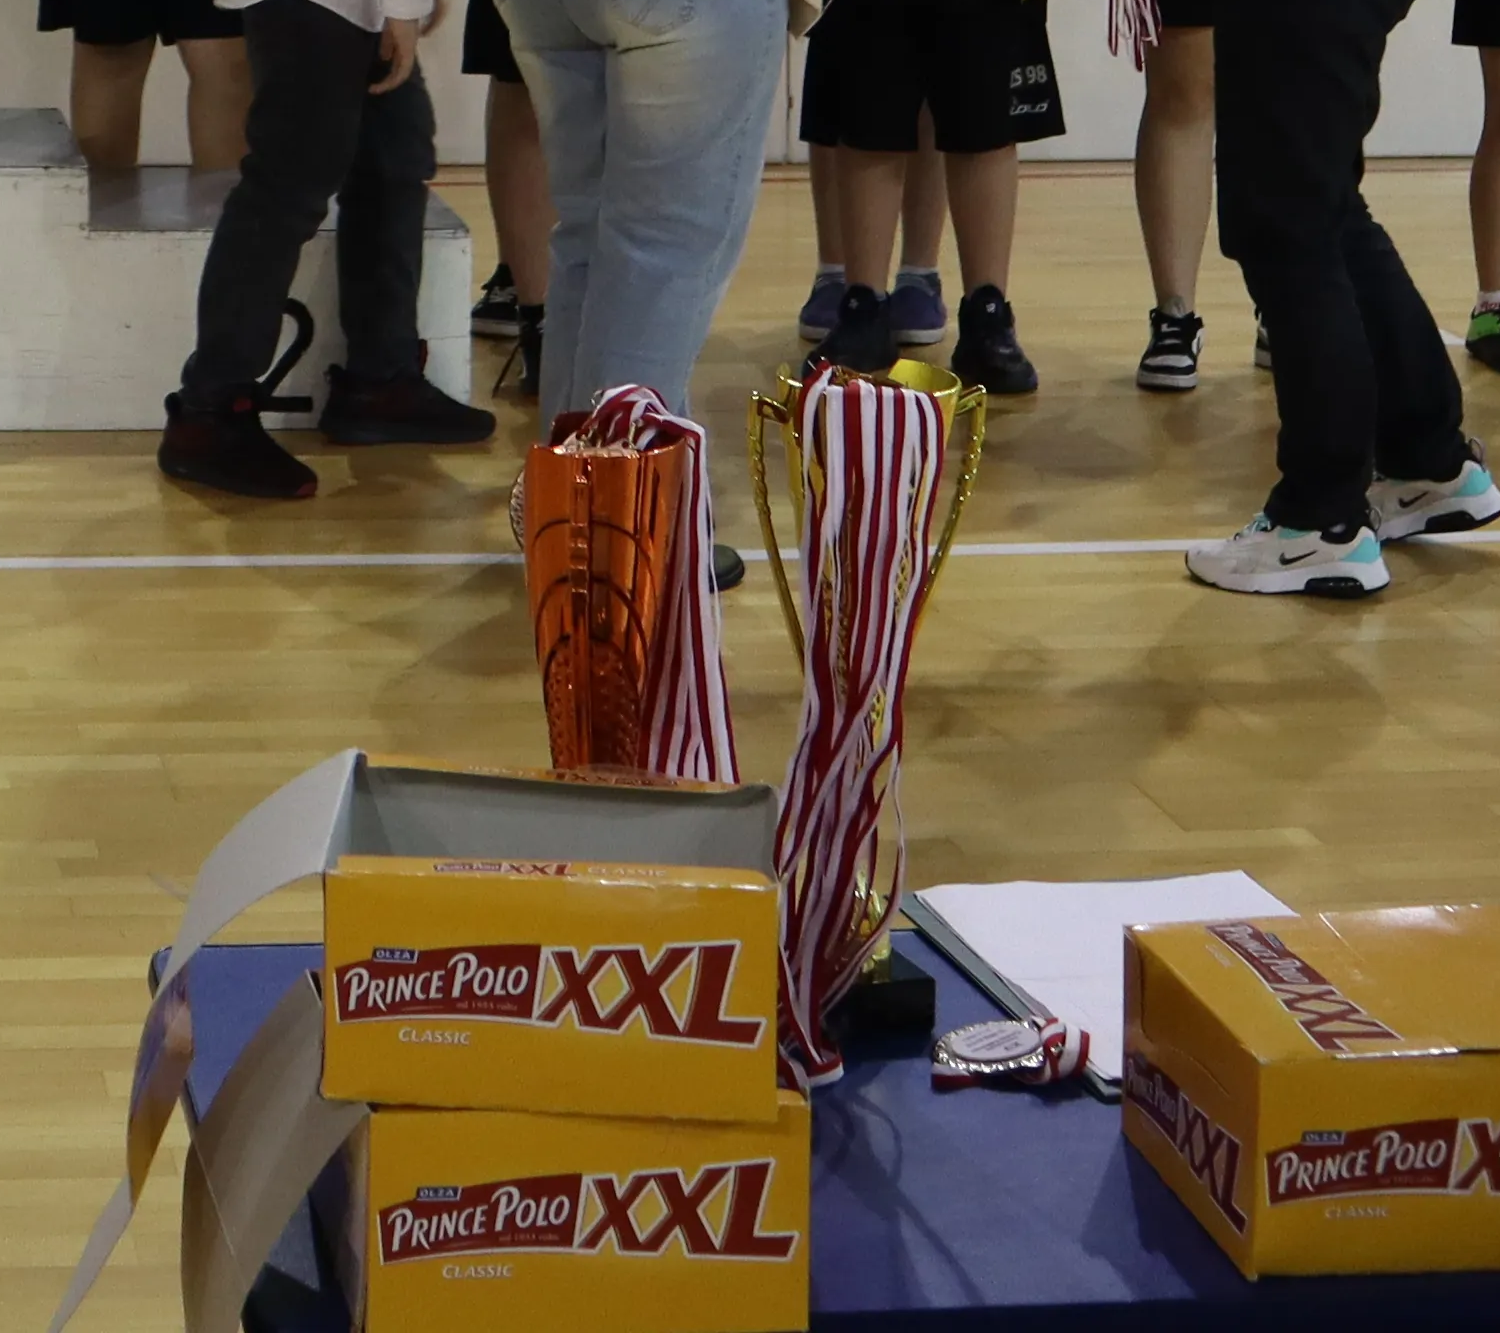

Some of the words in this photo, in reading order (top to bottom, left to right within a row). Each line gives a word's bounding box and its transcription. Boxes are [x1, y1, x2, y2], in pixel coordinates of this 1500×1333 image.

[1025, 65, 1047, 84] 98
[501, 862, 578, 877] XXL
[374, 949, 413, 961] OLZA
[343, 965, 446, 1013] PRINCE
[446, 951, 530, 999] POLO
[535, 940, 767, 1049] XXL
[1268, 983, 1405, 1052] XXL
[398, 1027, 471, 1046] CLASSIC
[1175, 1091, 1249, 1240] XXL
[1274, 1147, 1370, 1194] PRINCE
[1372, 1130, 1449, 1176] POLO
[418, 1187, 457, 1199] OLZA
[387, 1204, 490, 1253] PRINCE
[490, 1184, 571, 1233] POLO
[573, 1156, 800, 1263] XXL
[441, 1263, 514, 1280] CLASSIC
